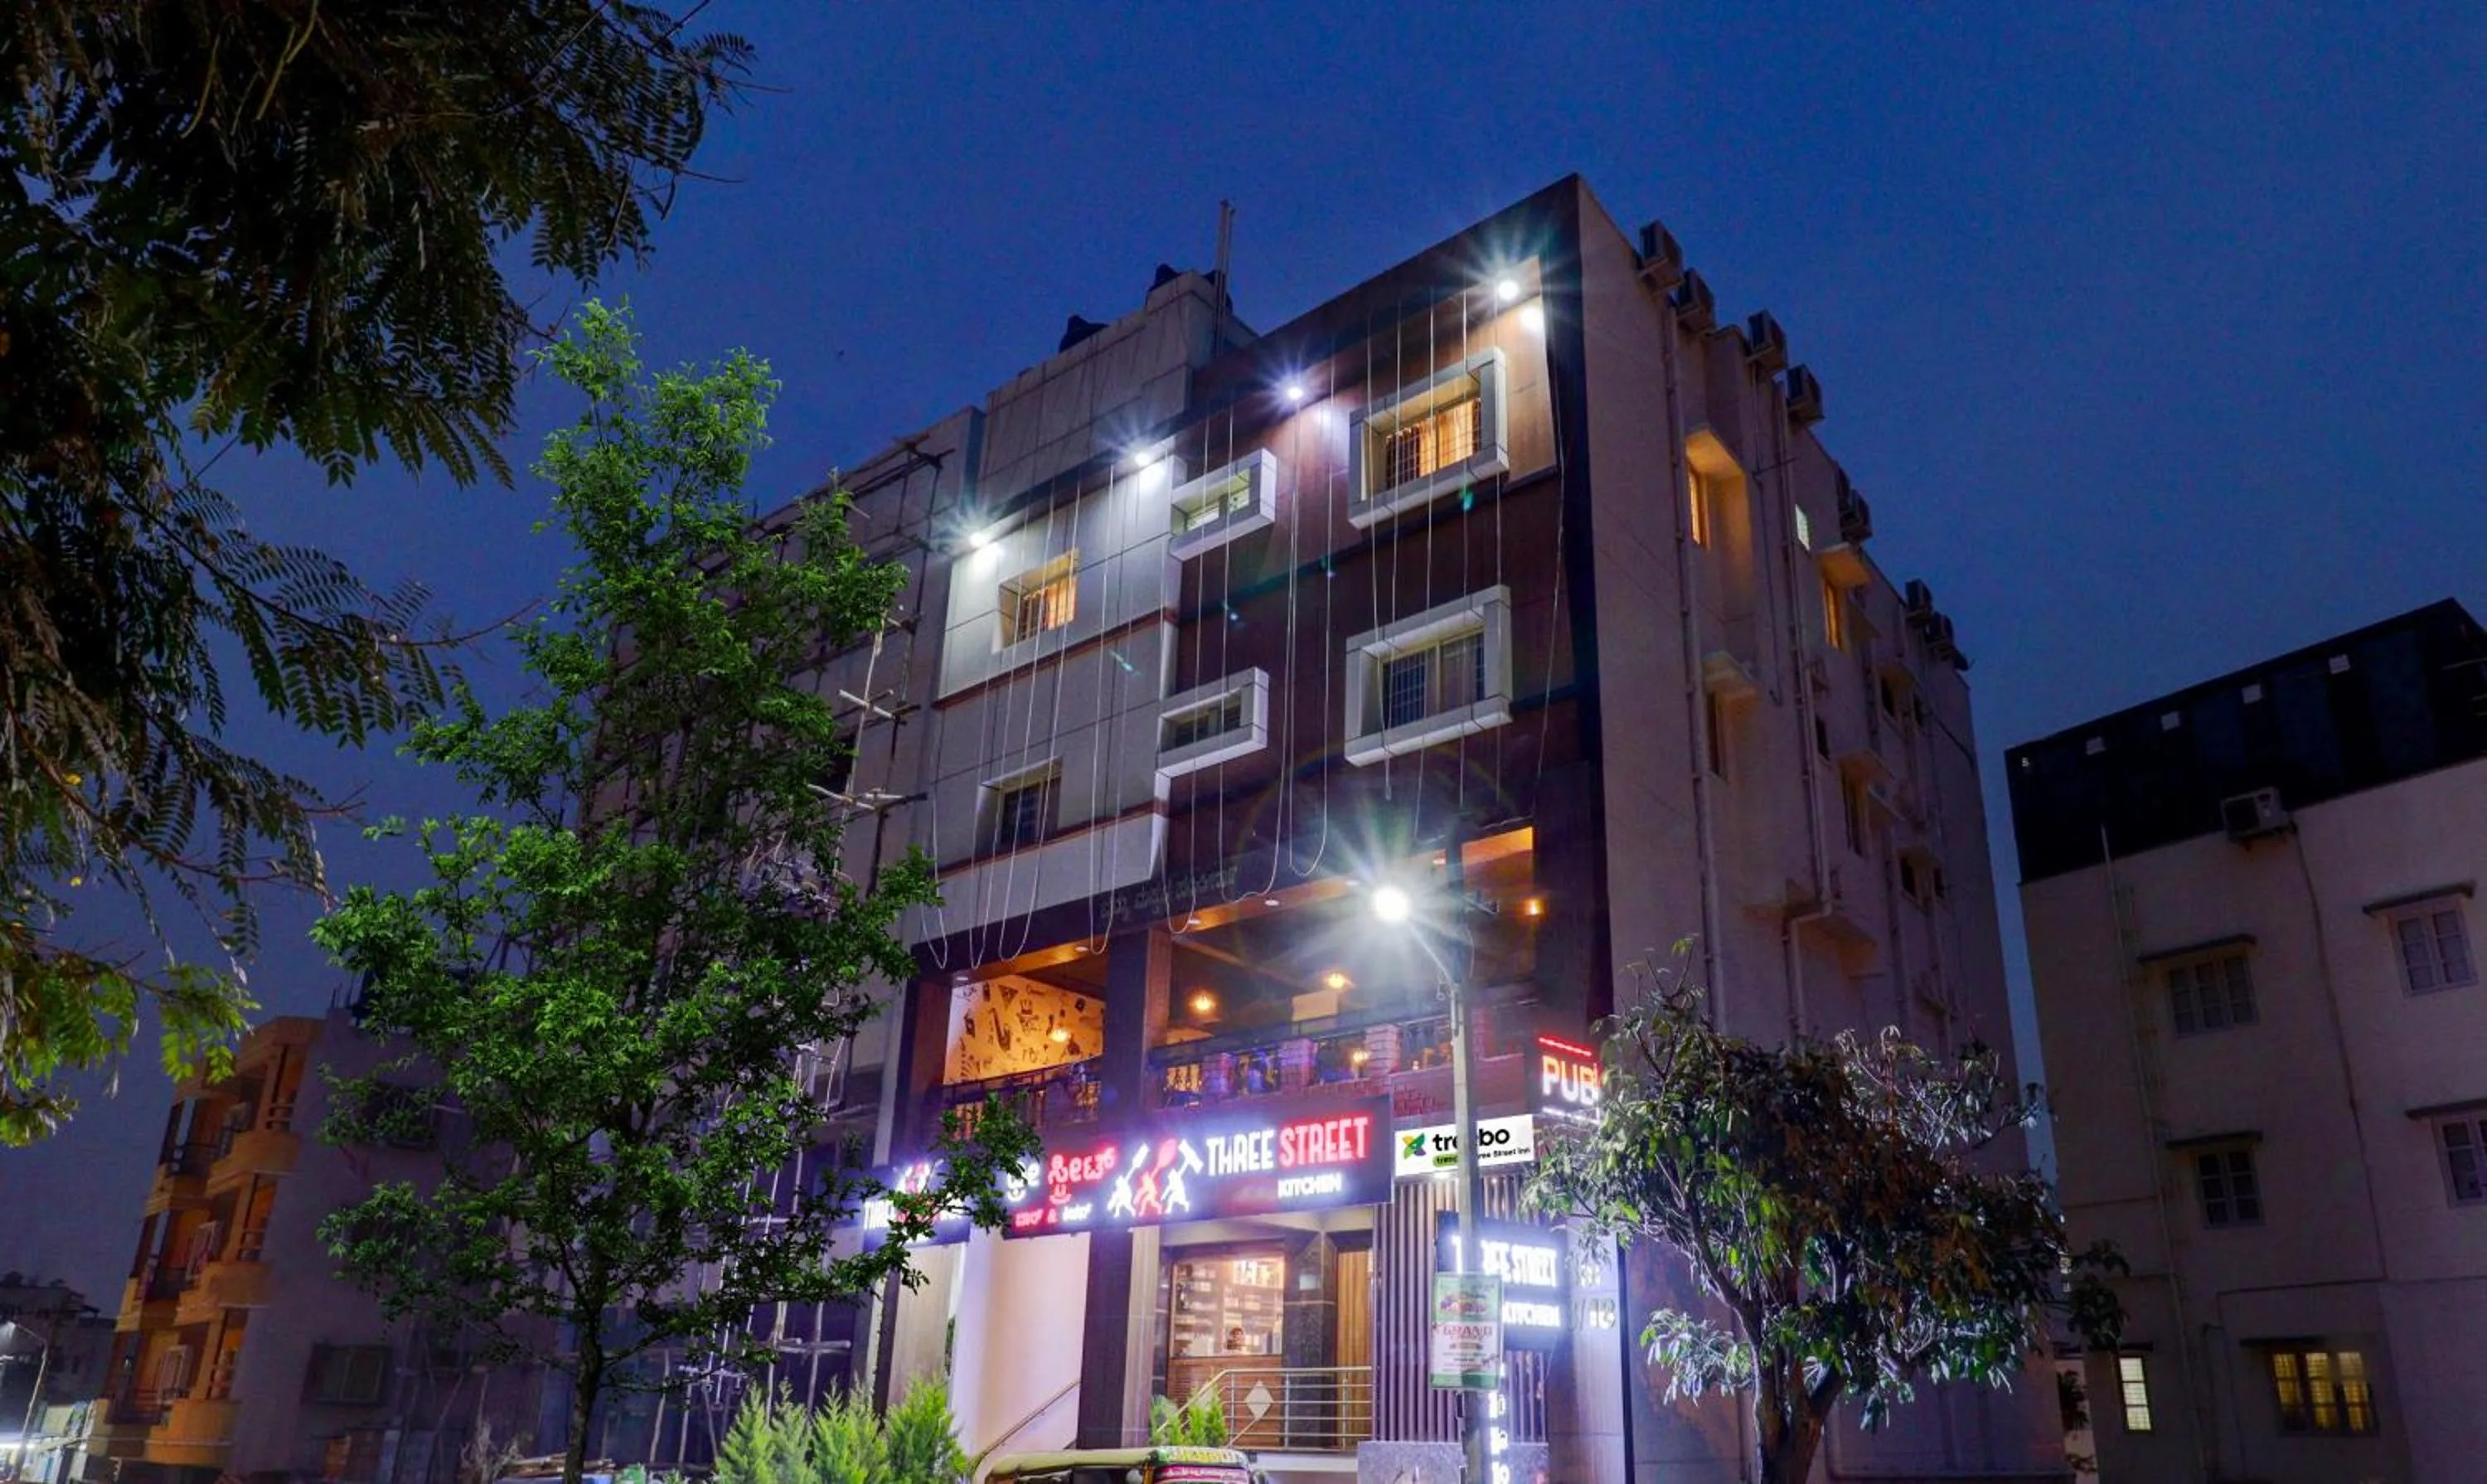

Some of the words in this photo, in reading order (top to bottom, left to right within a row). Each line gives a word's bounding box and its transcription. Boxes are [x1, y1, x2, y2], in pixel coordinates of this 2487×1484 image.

[1542, 1055, 1597, 1105] PUB
[1206, 1129, 1275, 1176] THREE
[1279, 1116, 1369, 1168] STREET
[1433, 1128, 1510, 1152] trbo
[1493, 1148, 1516, 1157] Street
[1277, 1172, 1342, 1198] KITCHEN
[1511, 1245, 1557, 1286] STREET
